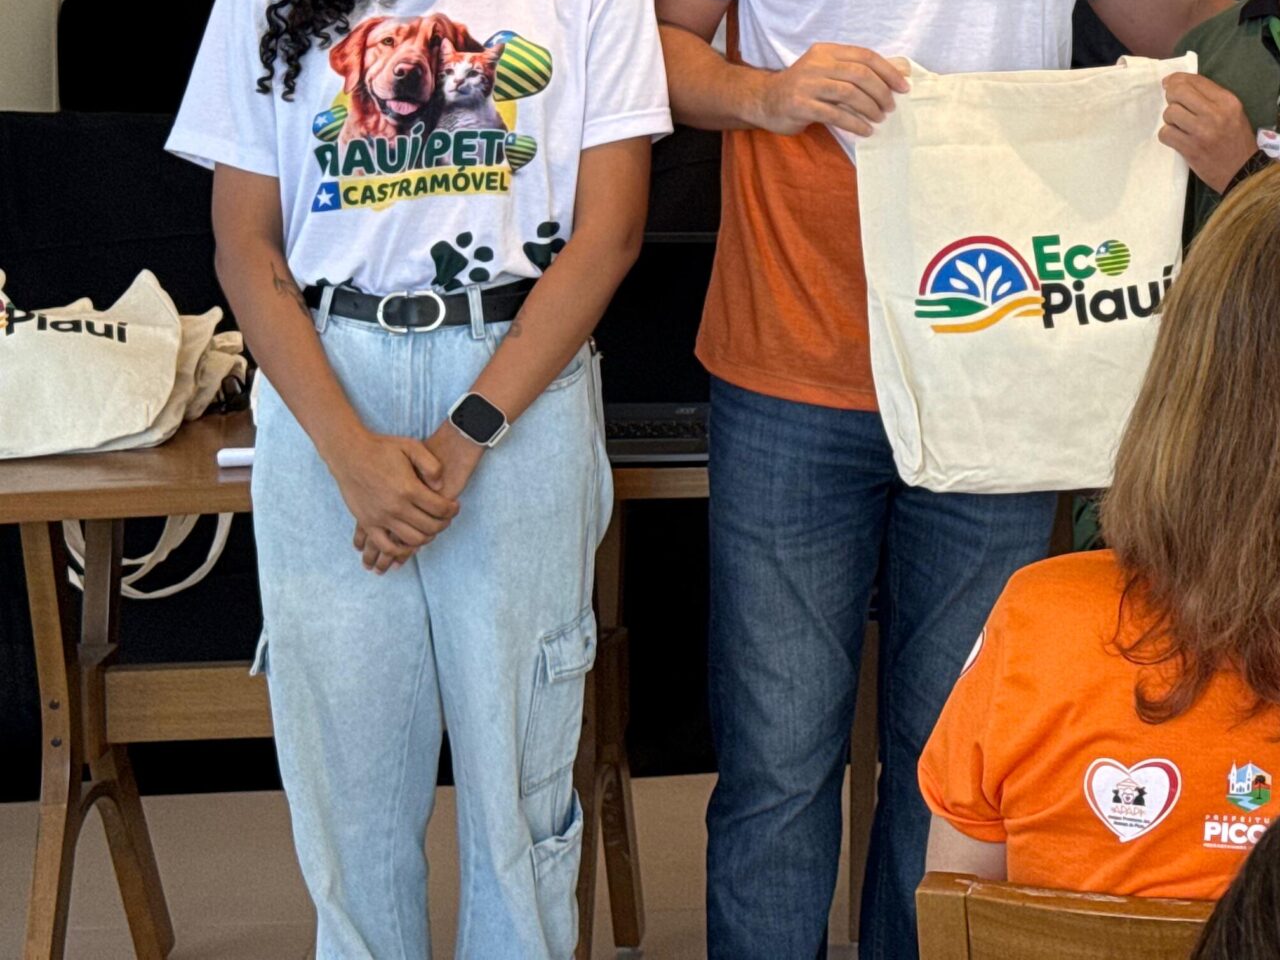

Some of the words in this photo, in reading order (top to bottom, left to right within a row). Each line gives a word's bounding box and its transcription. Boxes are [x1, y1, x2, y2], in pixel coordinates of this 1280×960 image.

[424, 130, 506, 170] PET
[342, 167, 509, 206] CASTRAMÓVEL
[1205, 814, 1272, 825] PREFEITU
